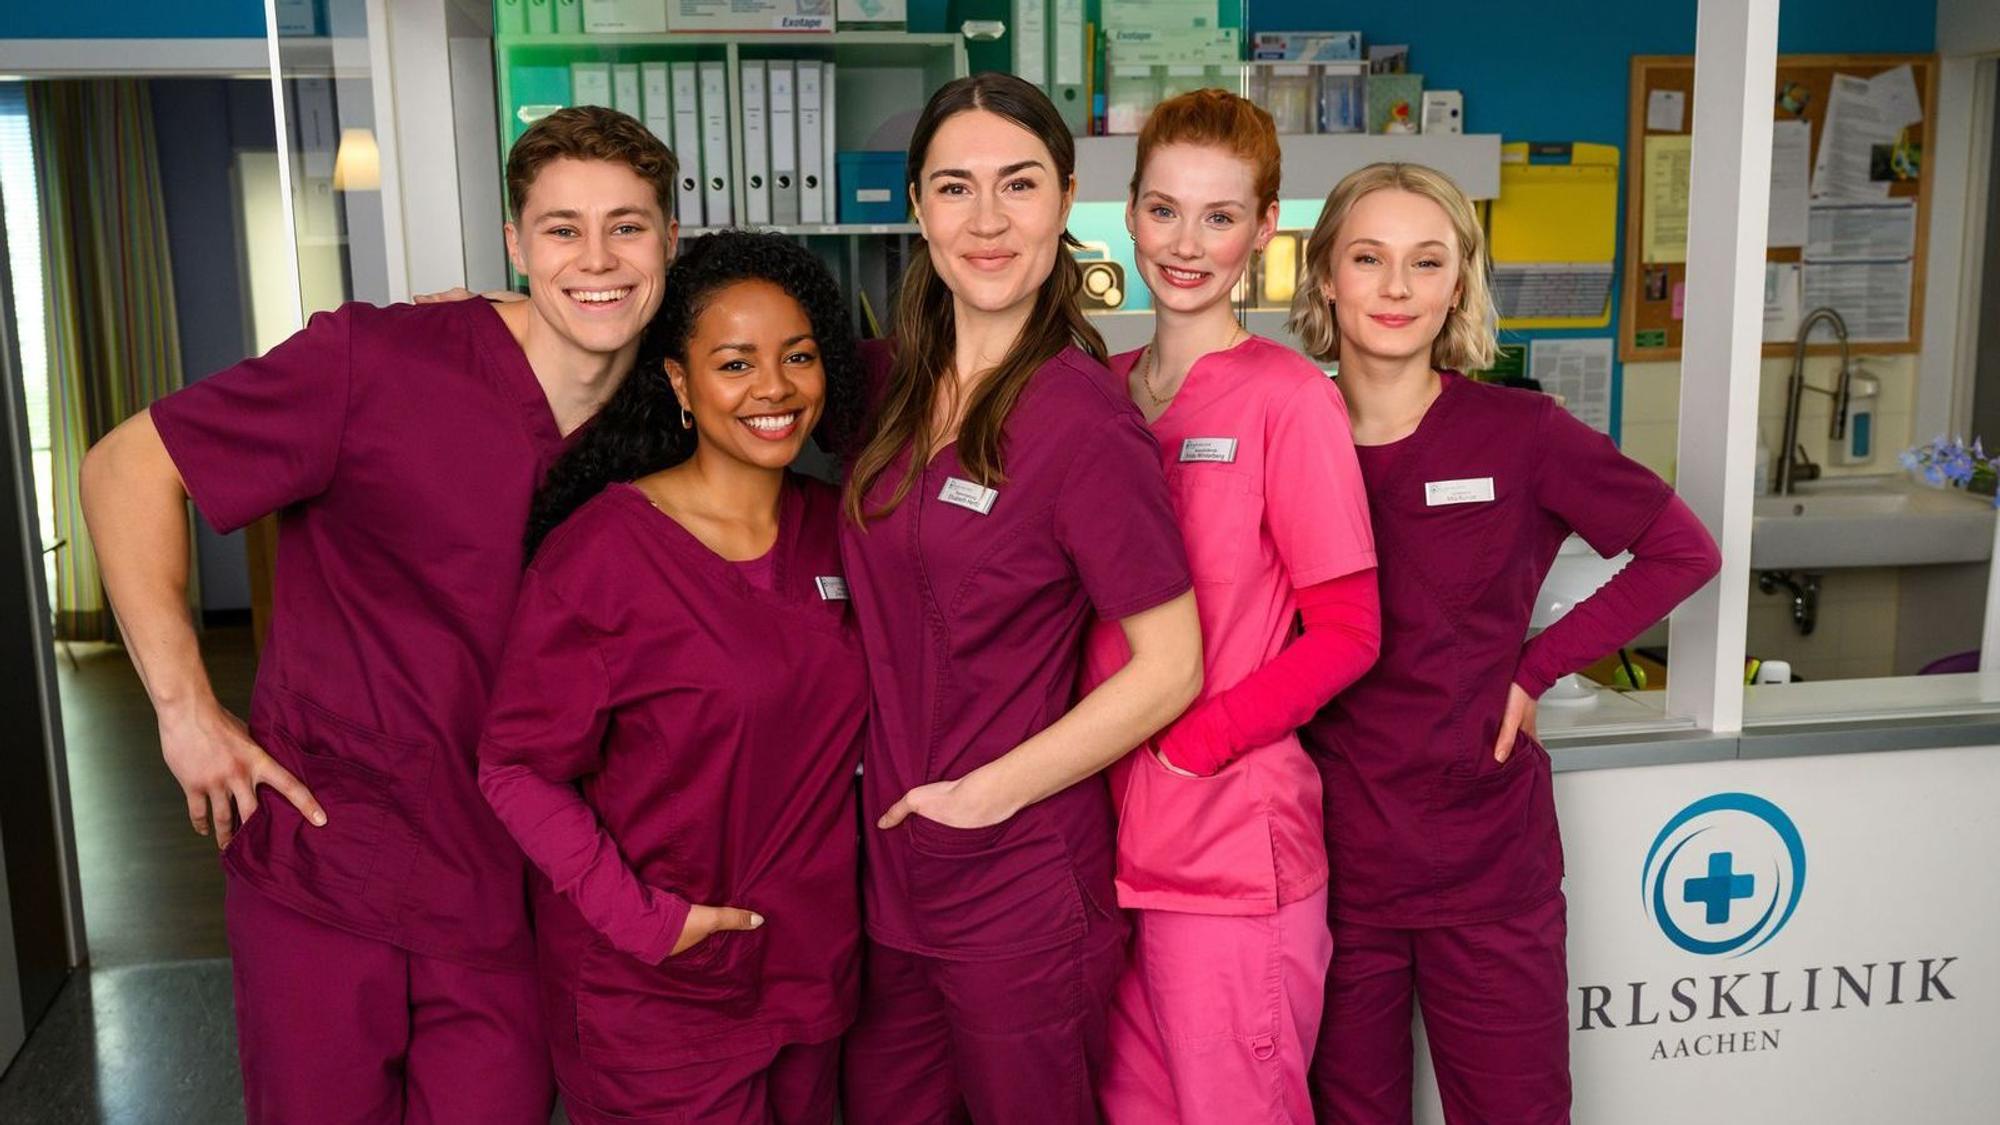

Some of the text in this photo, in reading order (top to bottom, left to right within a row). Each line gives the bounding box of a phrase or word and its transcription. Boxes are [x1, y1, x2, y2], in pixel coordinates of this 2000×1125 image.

[782, 16, 822, 29] Exotape
[1575, 956, 1959, 1032] RLSKLINIK
[1650, 1029, 1782, 1061] AACHEN
